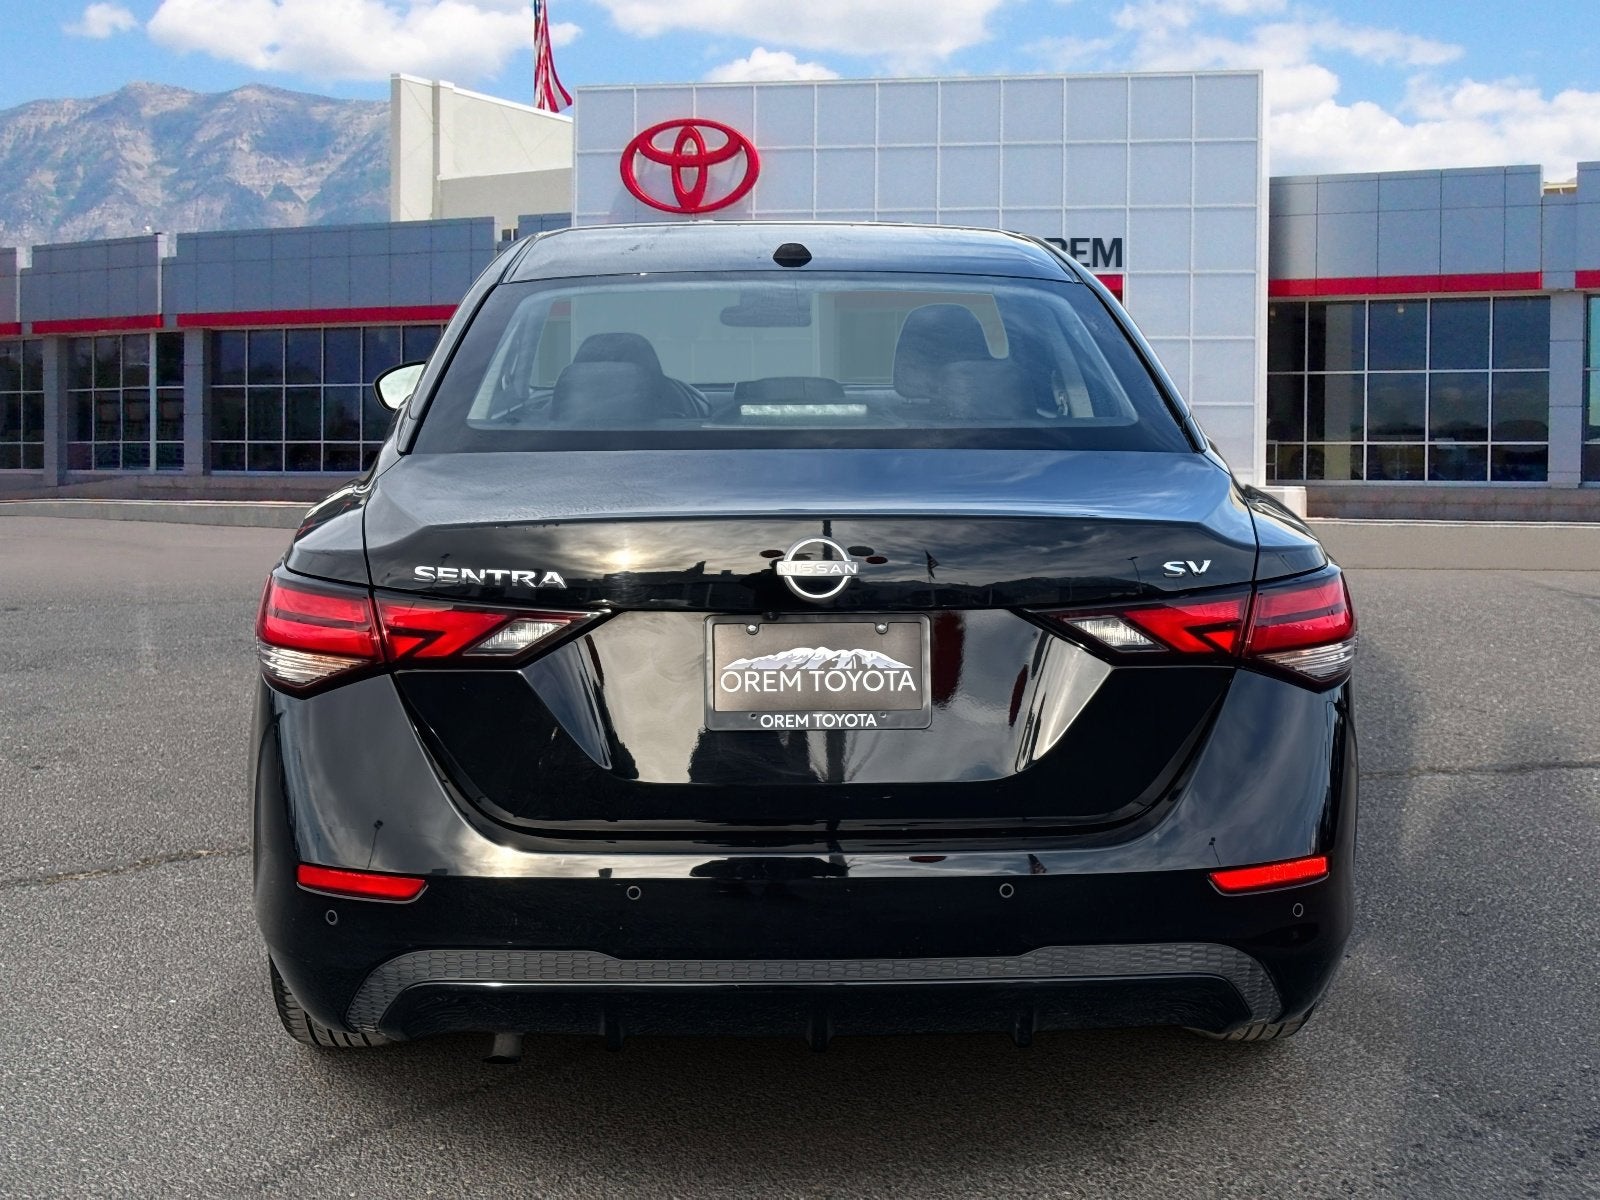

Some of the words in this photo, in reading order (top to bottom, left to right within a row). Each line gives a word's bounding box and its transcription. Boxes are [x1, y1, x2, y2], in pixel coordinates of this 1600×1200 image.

[413, 565, 568, 589] SENTRA
[779, 562, 857, 575] NISSAN
[1162, 559, 1212, 578] SV
[720, 670, 801, 693] OREM
[808, 670, 917, 692] TOYOTA
[760, 714, 809, 728] OREM
[813, 713, 877, 727] TOYOTA
